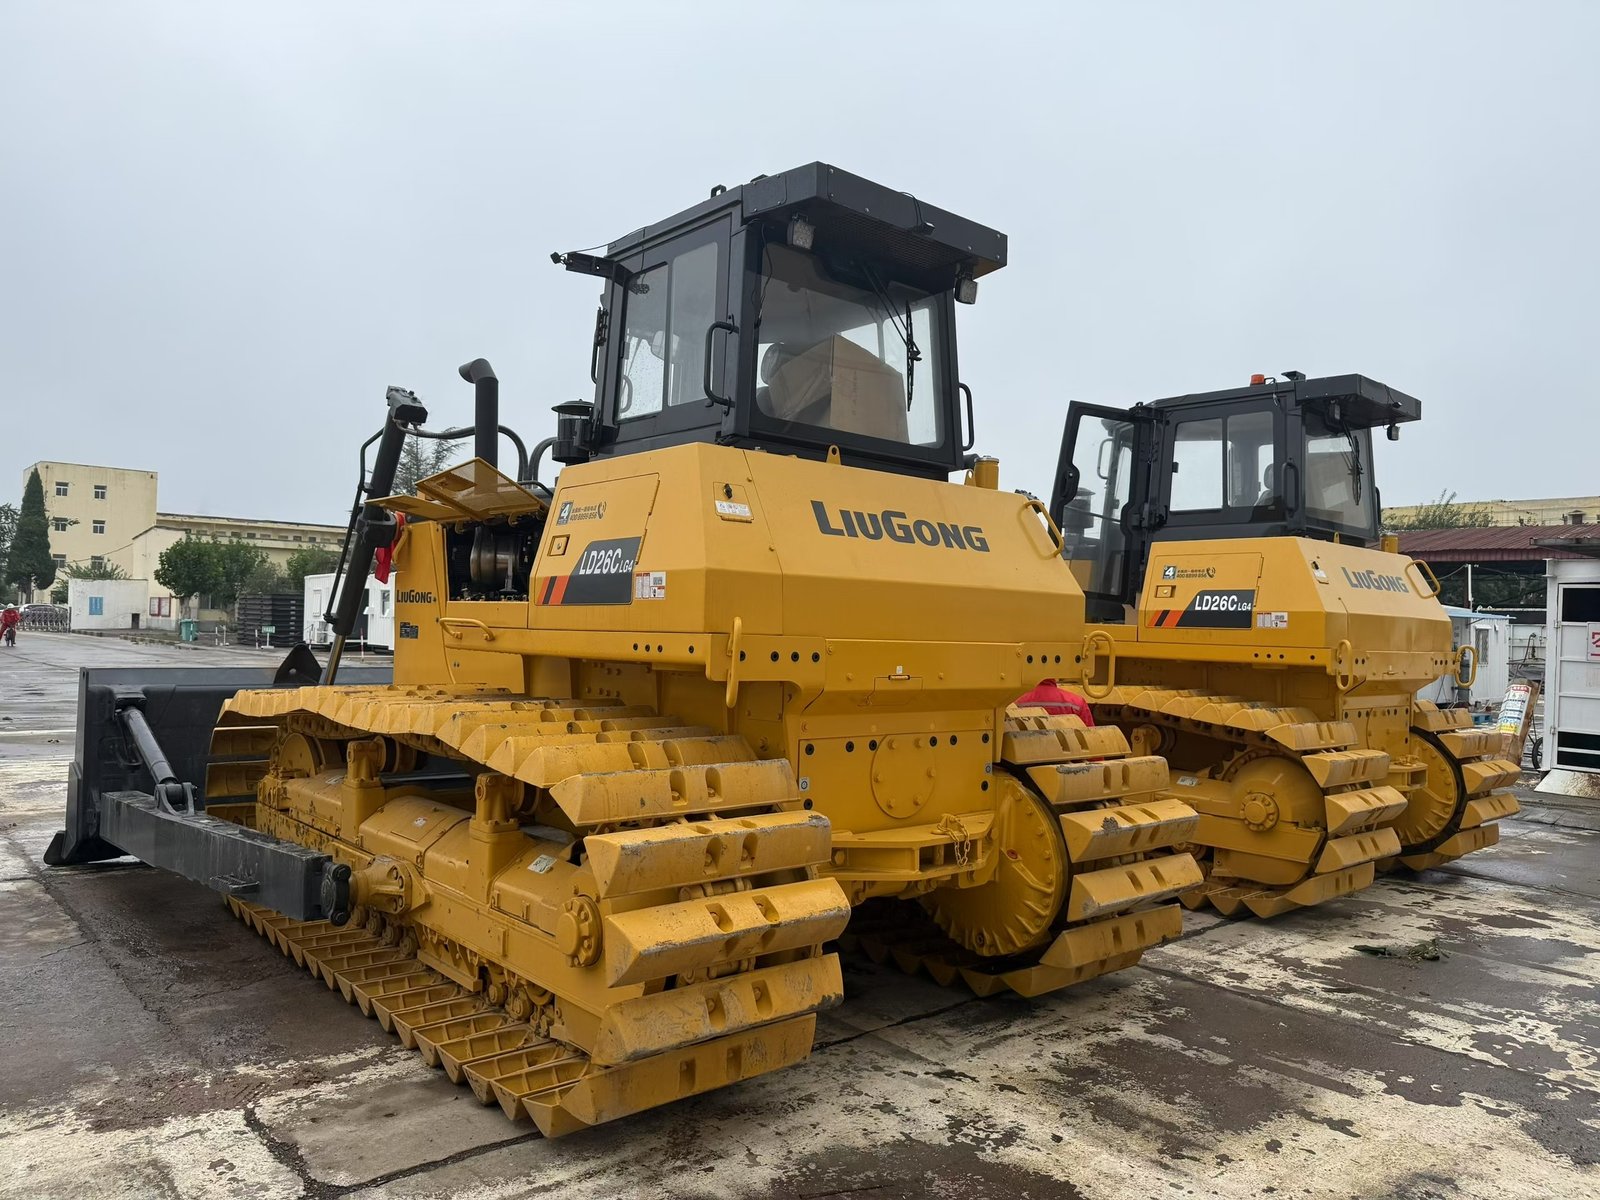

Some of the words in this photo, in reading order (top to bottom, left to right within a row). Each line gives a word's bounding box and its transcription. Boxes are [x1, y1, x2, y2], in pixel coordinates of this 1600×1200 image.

[579, 548, 622, 575] LD26C
[620, 560, 634, 573] LG4
[1194, 595, 1238, 611] LD26C
[1237, 602, 1252, 611] LG4
